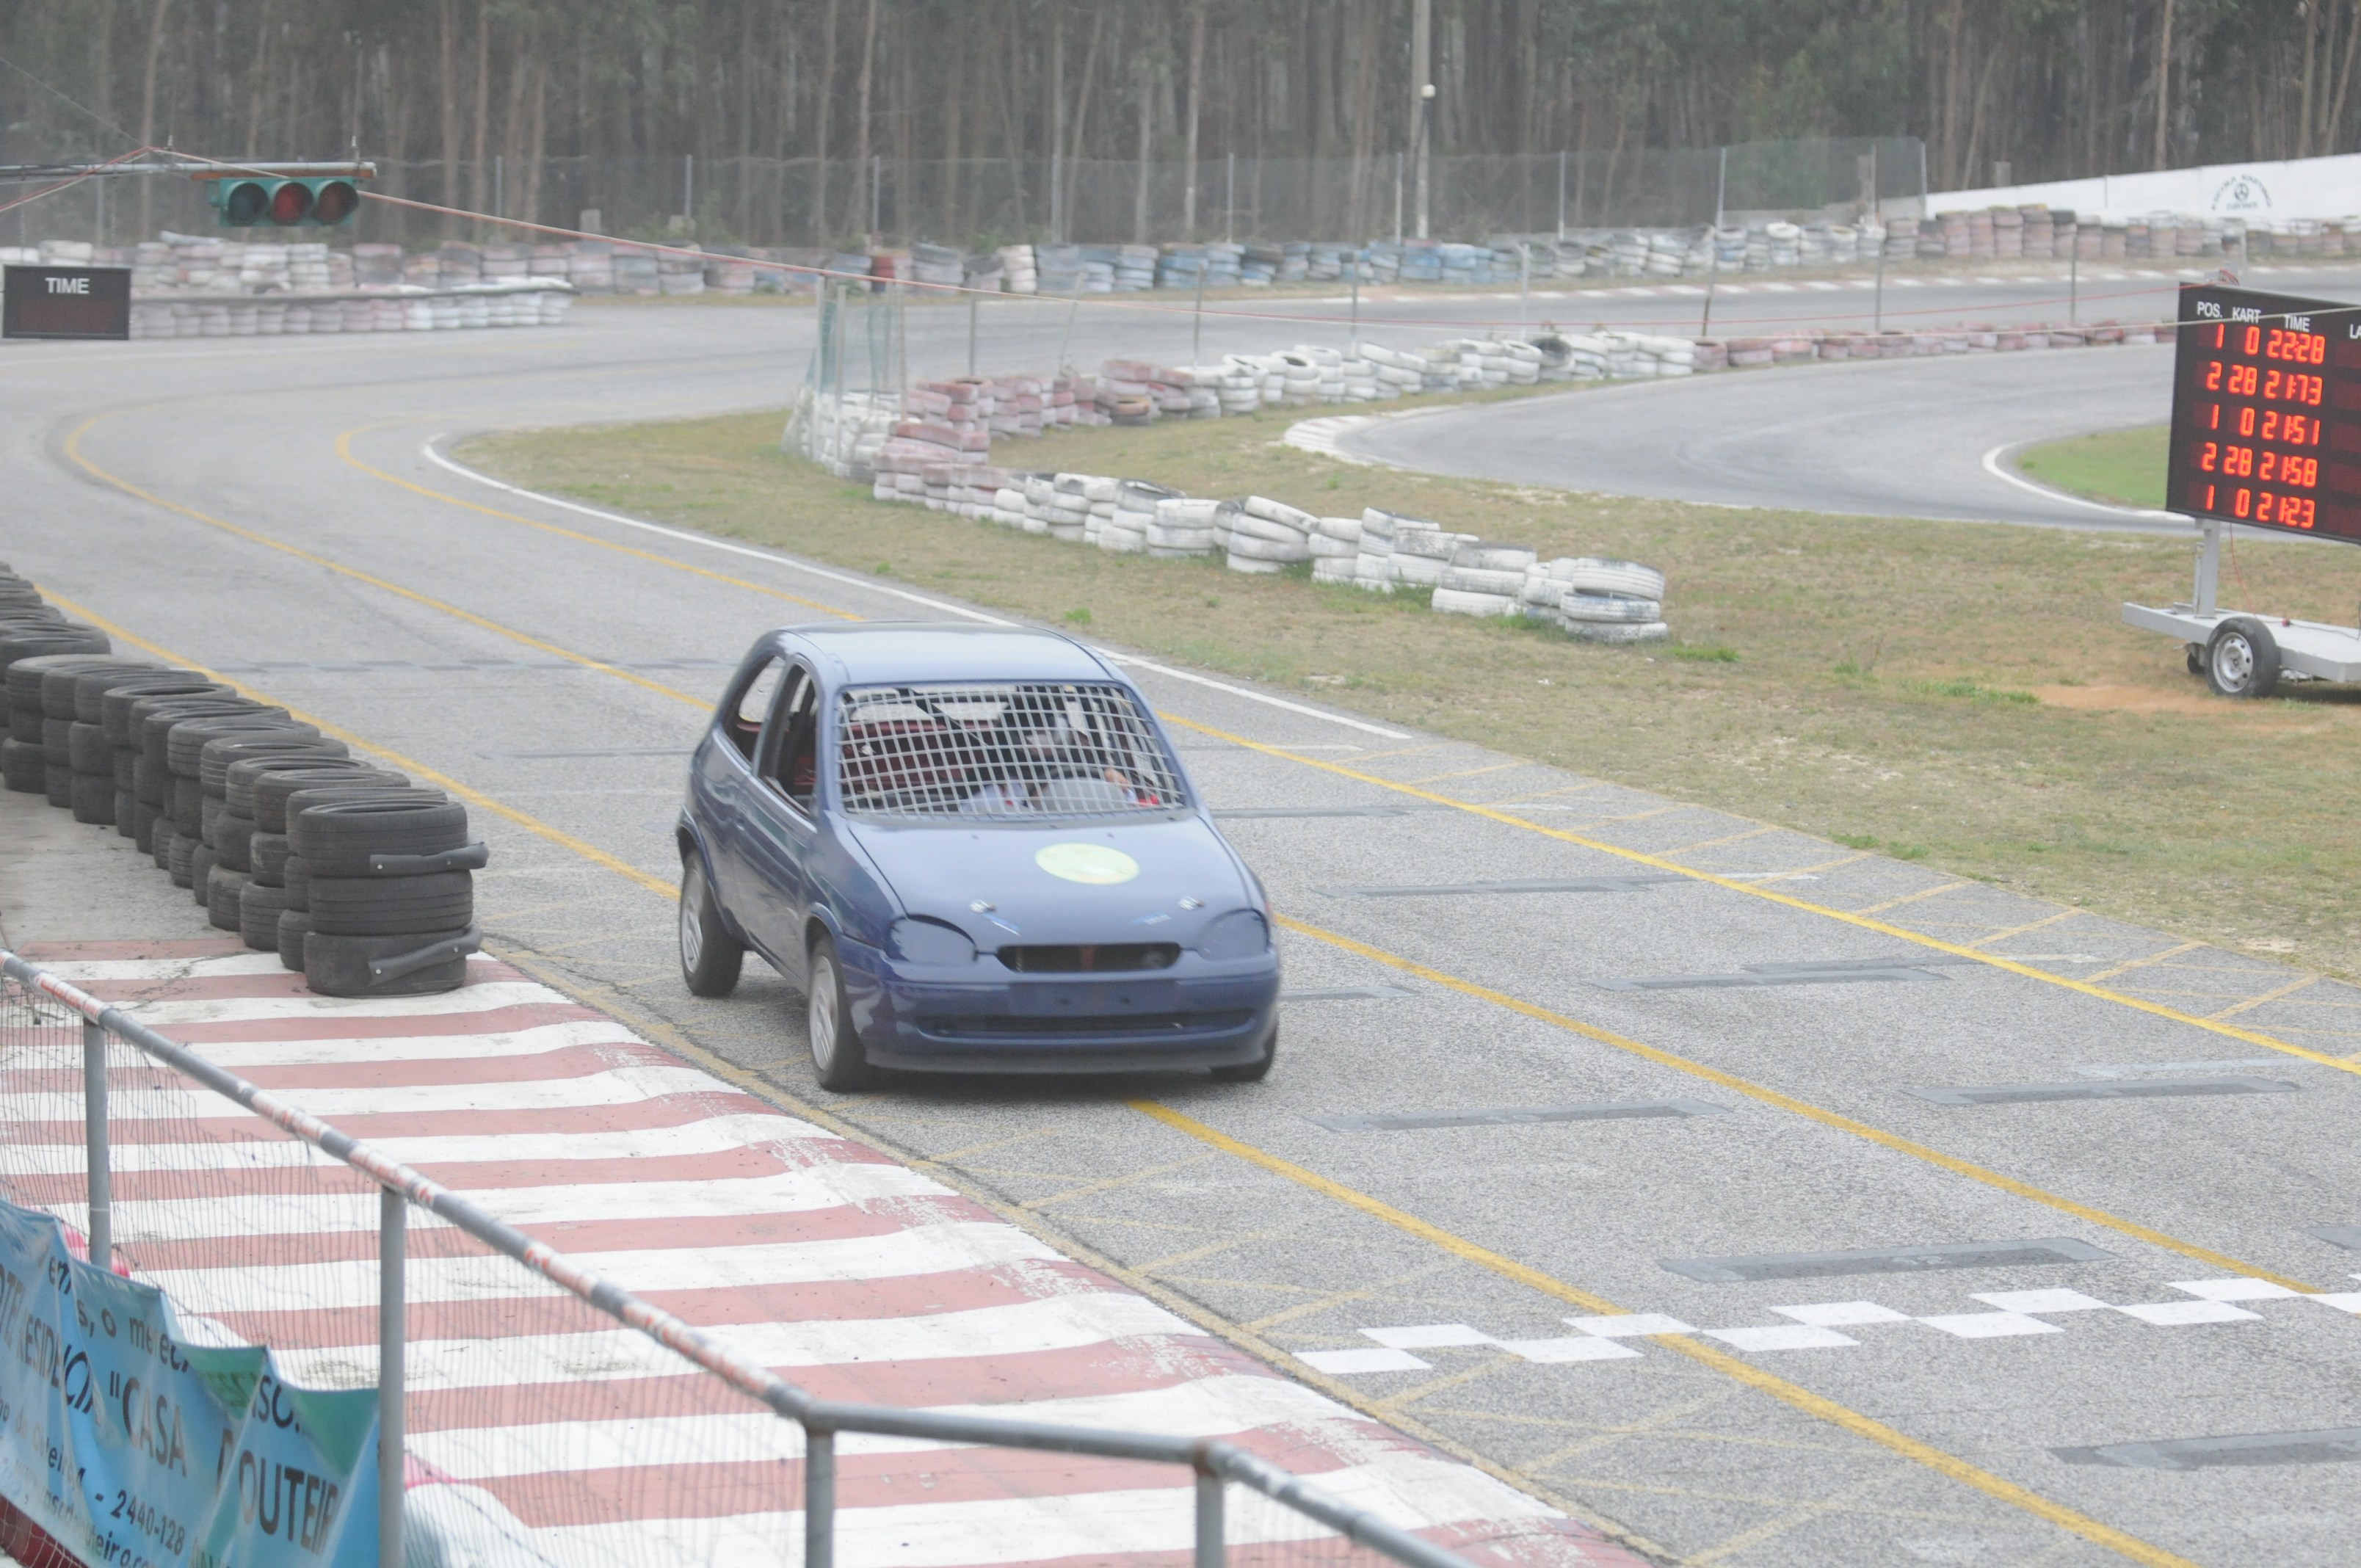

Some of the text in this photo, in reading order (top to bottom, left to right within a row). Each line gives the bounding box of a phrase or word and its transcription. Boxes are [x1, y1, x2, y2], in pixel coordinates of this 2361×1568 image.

[45, 277, 90, 294] TIME
[2197, 301, 2361, 339] POS. KART TIME LA
[2216, 323, 2224, 349] 1
[2244, 326, 2260, 355] 0
[2206, 361, 2222, 391] 2
[2227, 364, 2257, 396] 28
[2211, 404, 2219, 429] 1
[2240, 407, 2255, 437] 0
[2202, 443, 2217, 471] 2
[2223, 446, 2252, 477] 28
[2206, 484, 2215, 510] 1
[2235, 488, 2251, 518] 0
[110, 1489, 185, 1556] 2440-128
